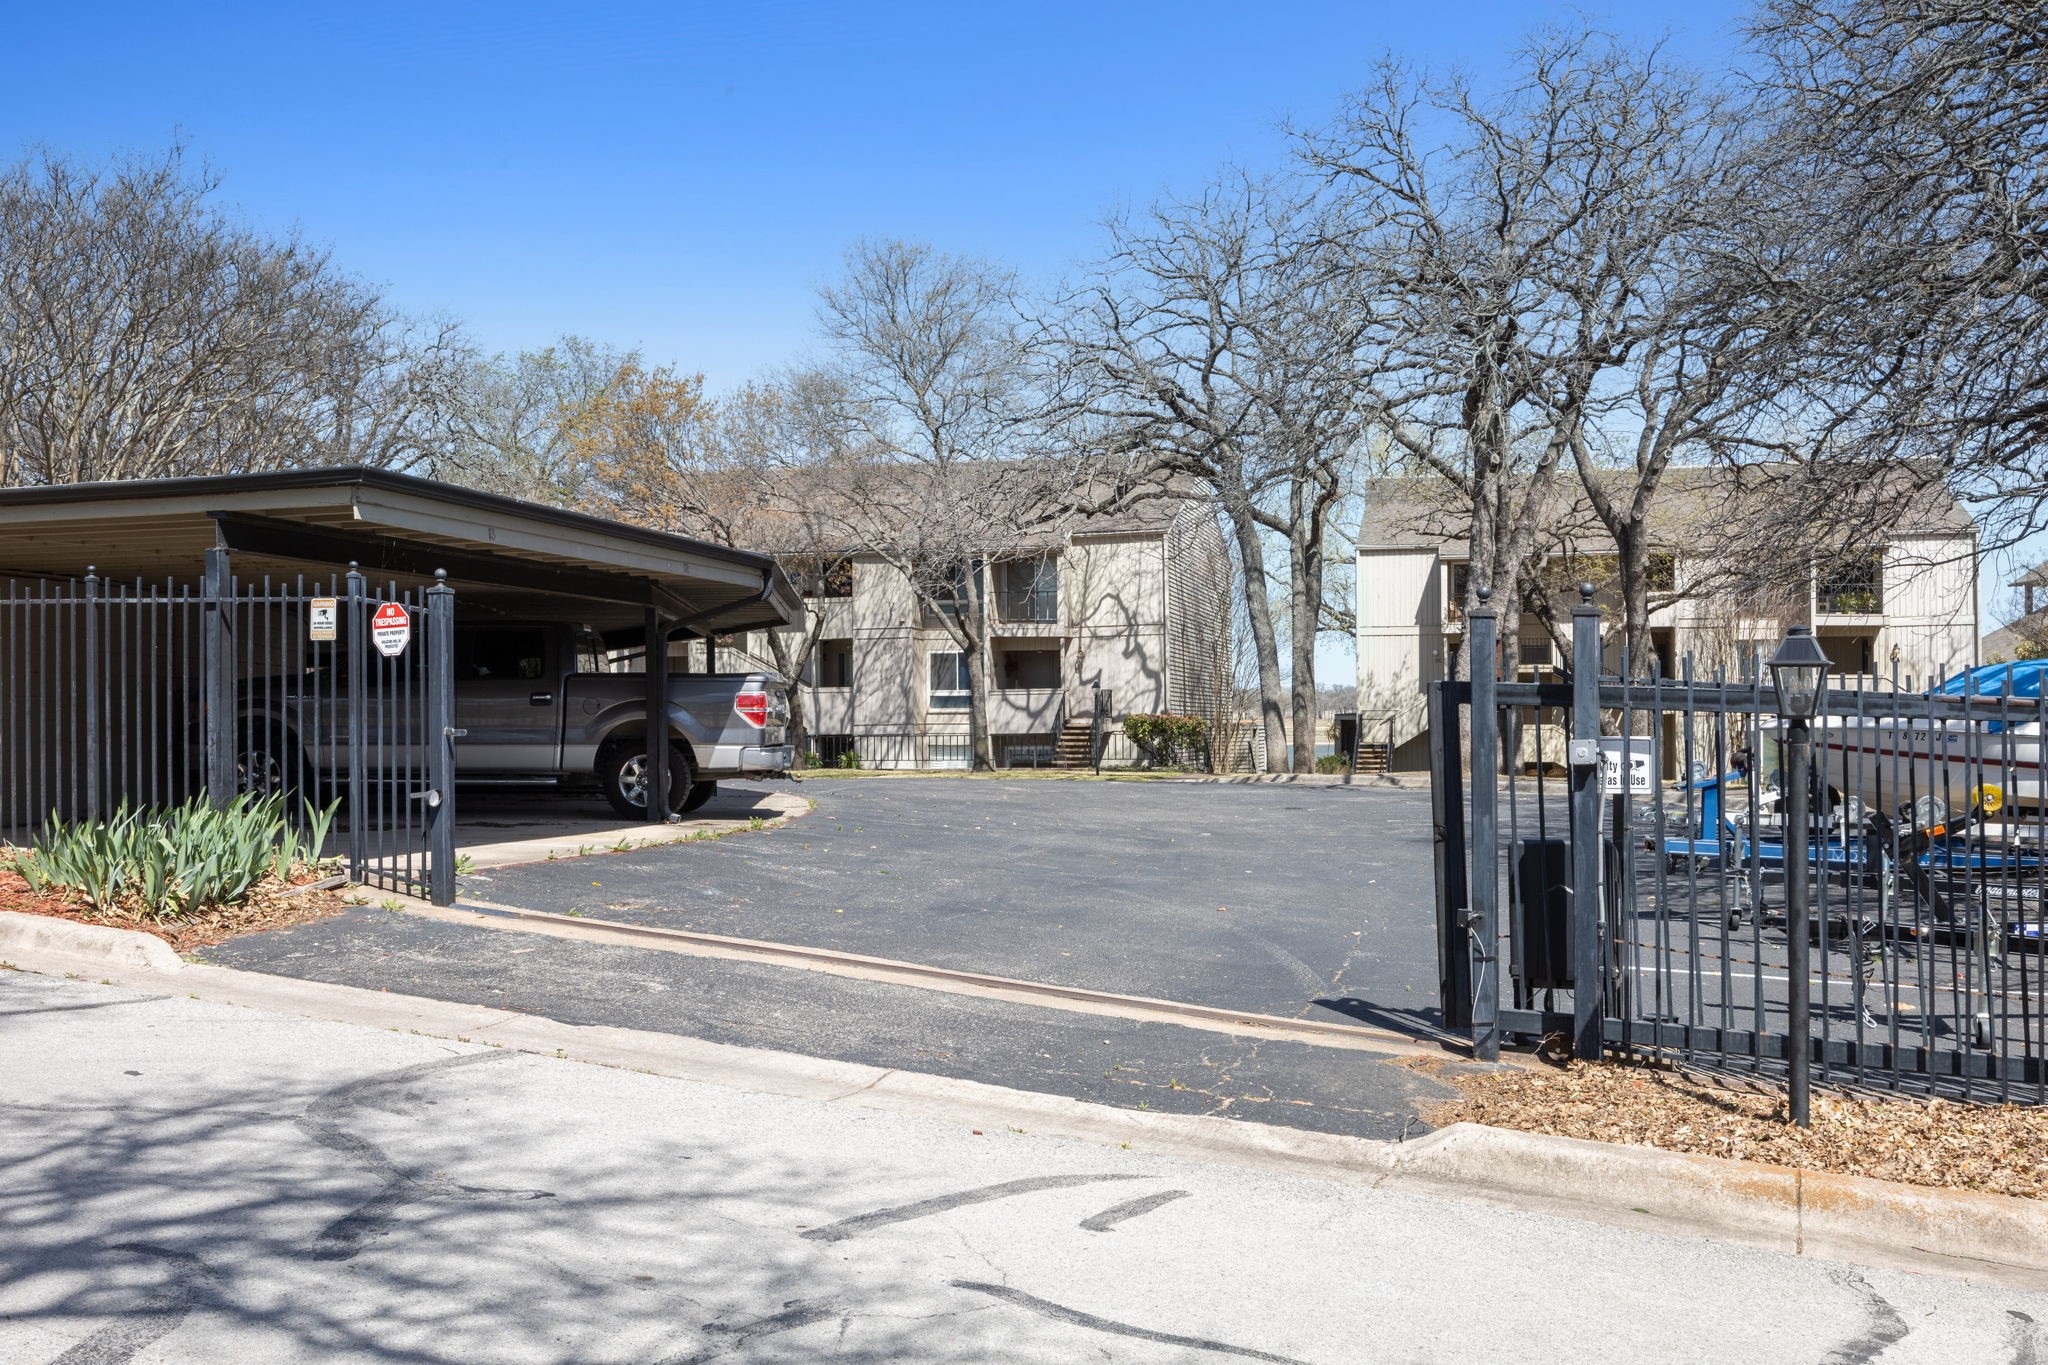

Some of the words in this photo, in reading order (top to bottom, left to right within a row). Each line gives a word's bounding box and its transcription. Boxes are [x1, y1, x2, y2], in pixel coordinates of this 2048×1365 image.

[386, 607, 395, 617] NO
[375, 616, 407, 628] TRESPASSING
[1630, 774, 1646, 786] Use
